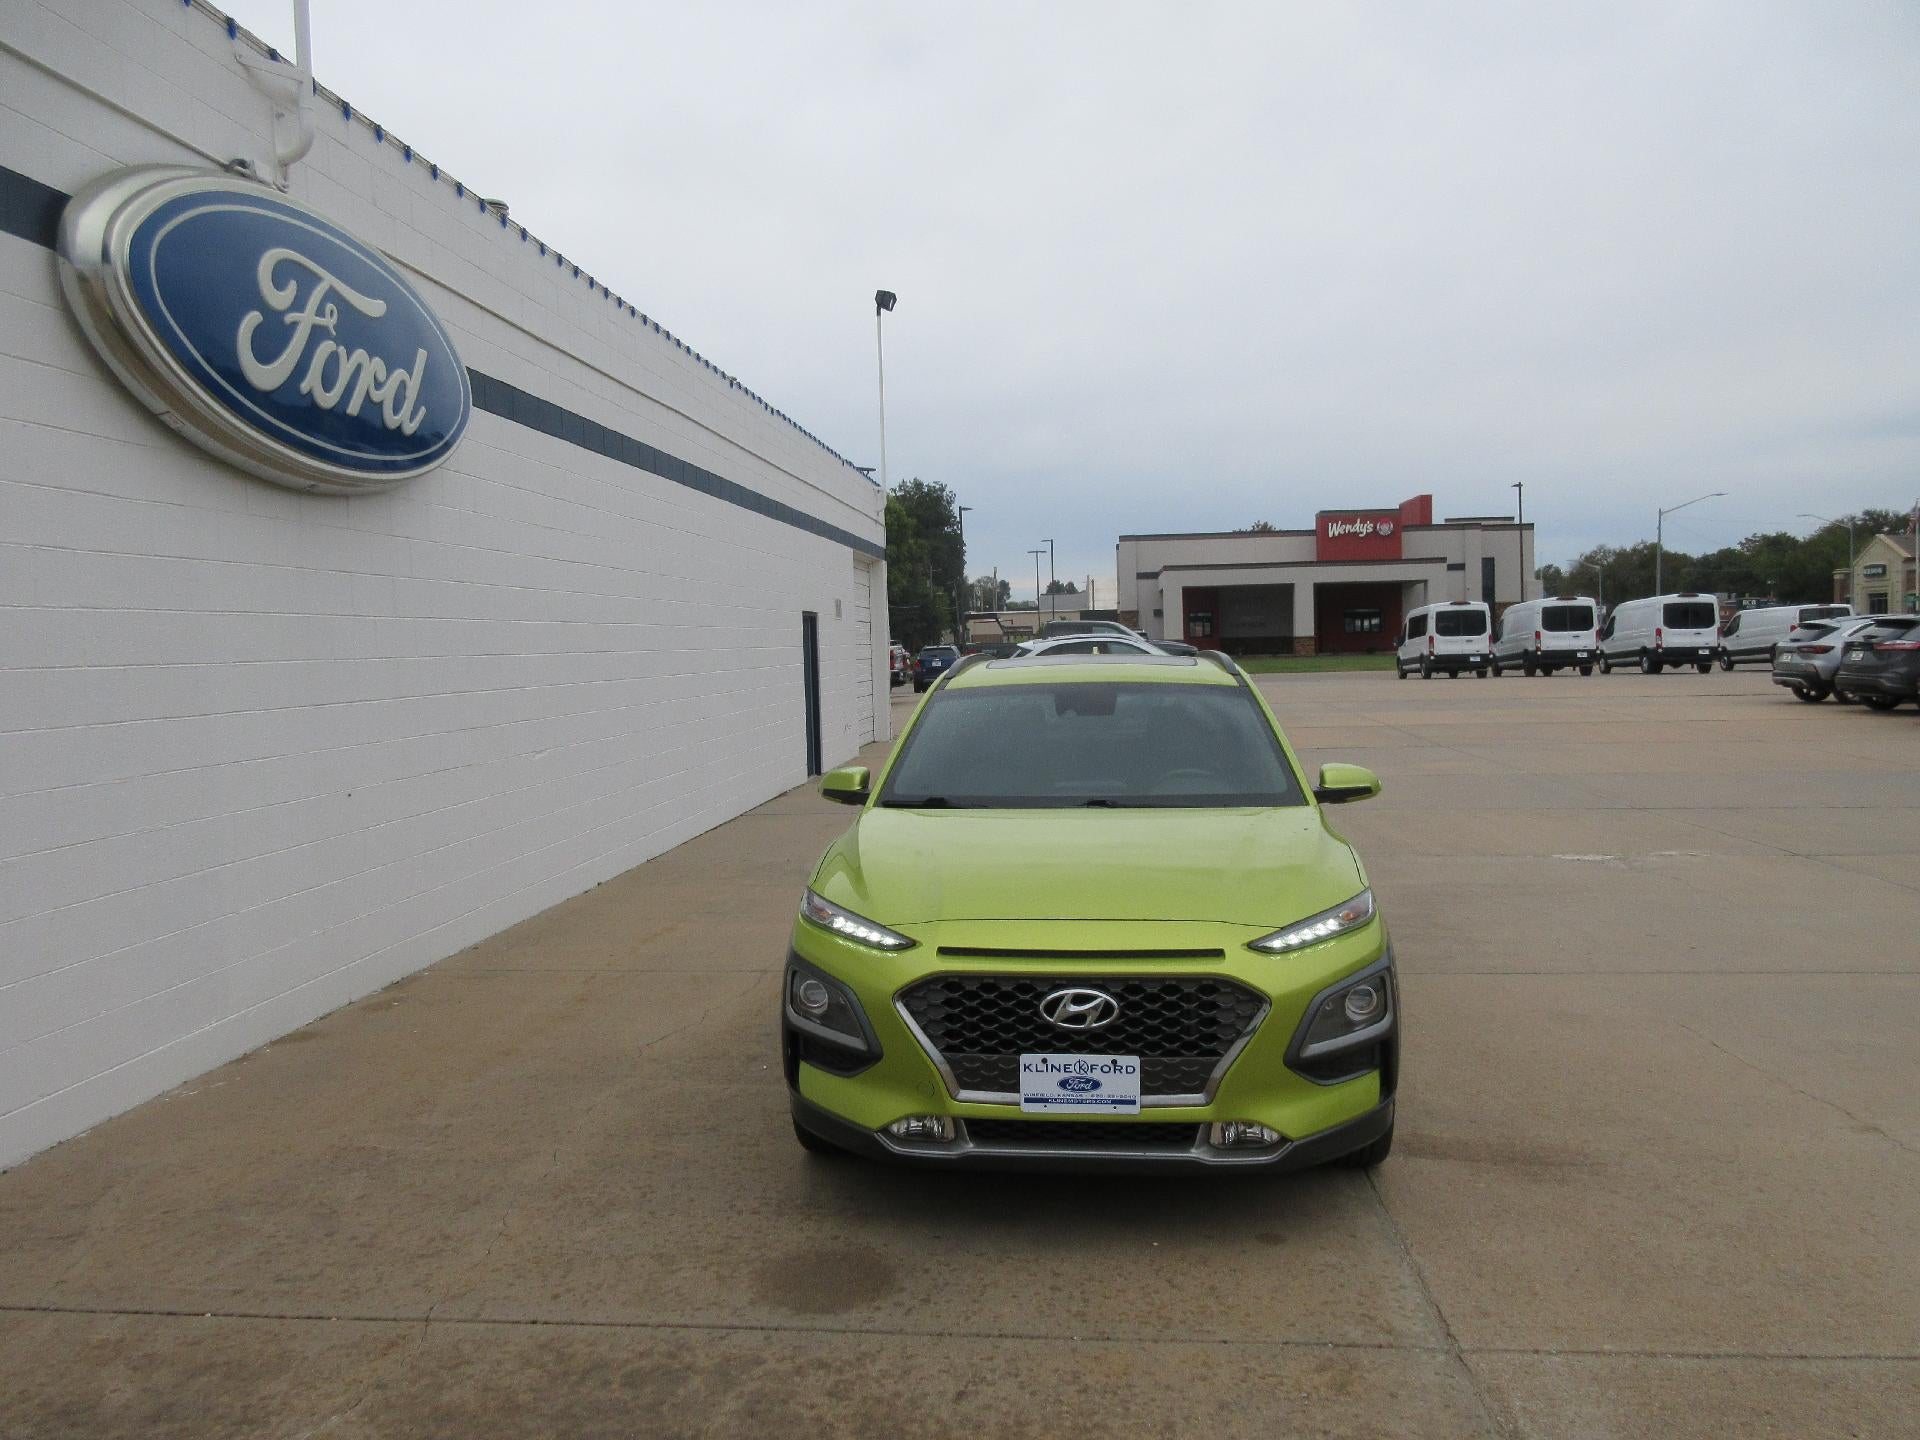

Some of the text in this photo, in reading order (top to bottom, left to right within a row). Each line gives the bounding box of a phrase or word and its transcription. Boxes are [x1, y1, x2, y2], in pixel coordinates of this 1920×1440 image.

[236, 247, 428, 437] Ford
[1328, 518, 1374, 538] Wendy's
[1023, 1063, 1073, 1073] KLINE
[1090, 1064, 1136, 1074] FORD
[1066, 1078, 1093, 1090] Ford
